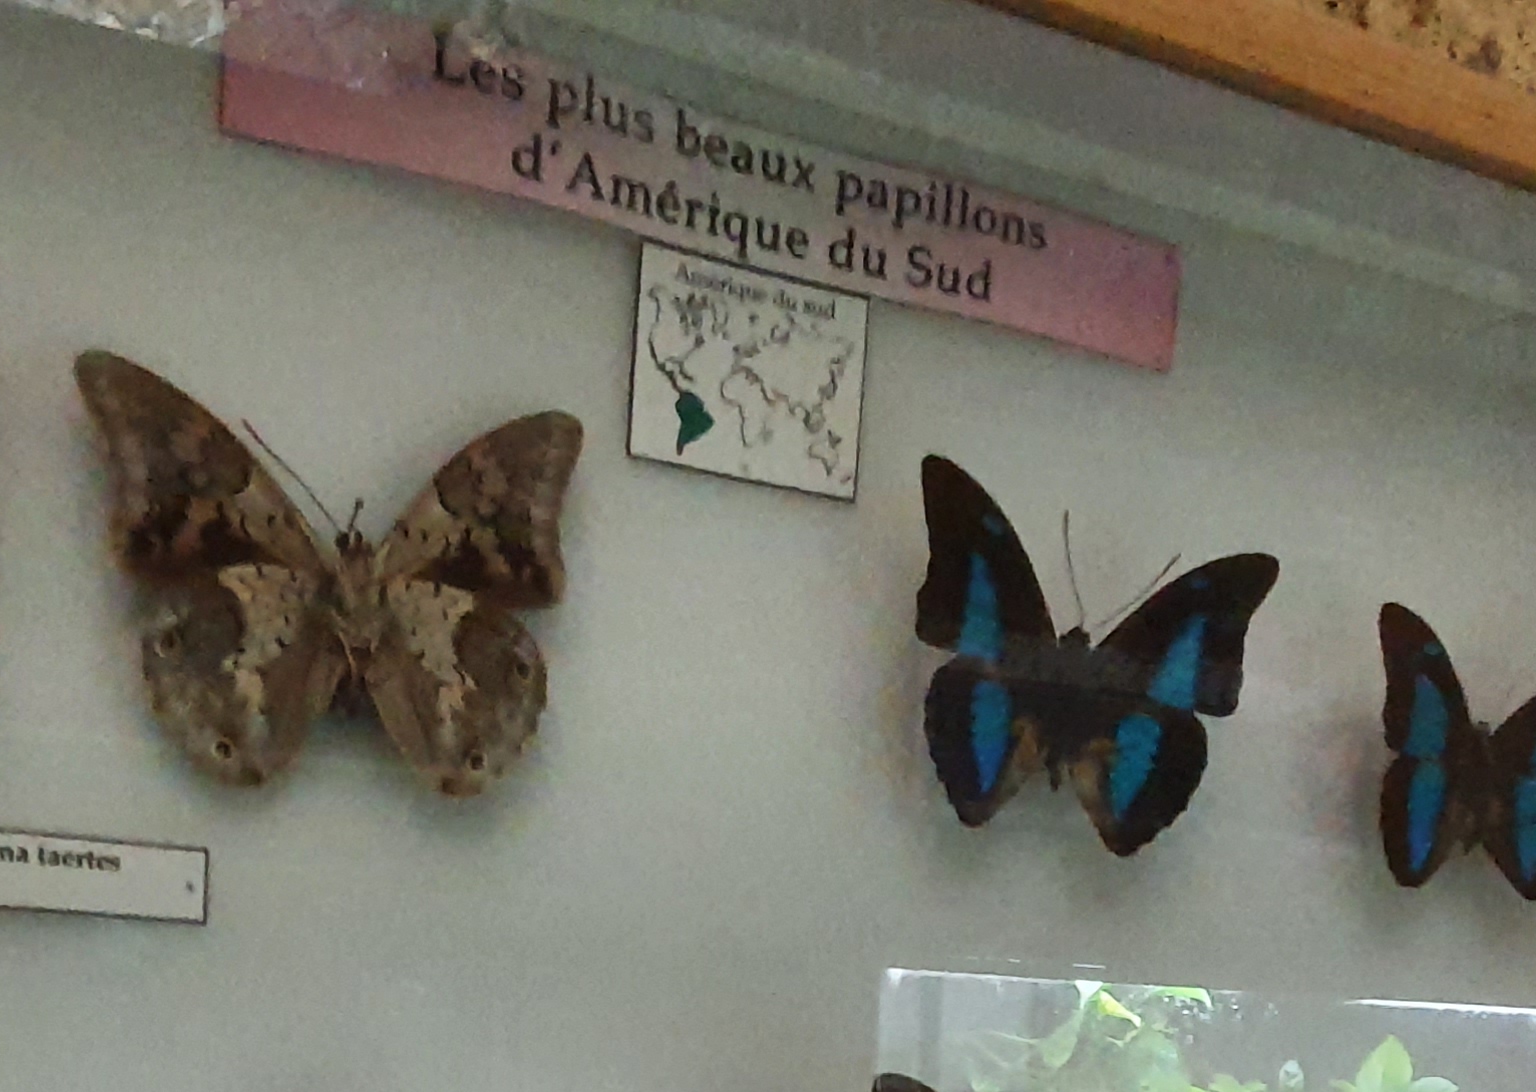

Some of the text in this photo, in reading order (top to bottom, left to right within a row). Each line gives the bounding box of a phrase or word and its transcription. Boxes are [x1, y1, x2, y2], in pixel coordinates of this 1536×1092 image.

[432, 28, 1048, 251] Les plus beaux papillons
[511, 132, 993, 302] d'Amérique du Sud
